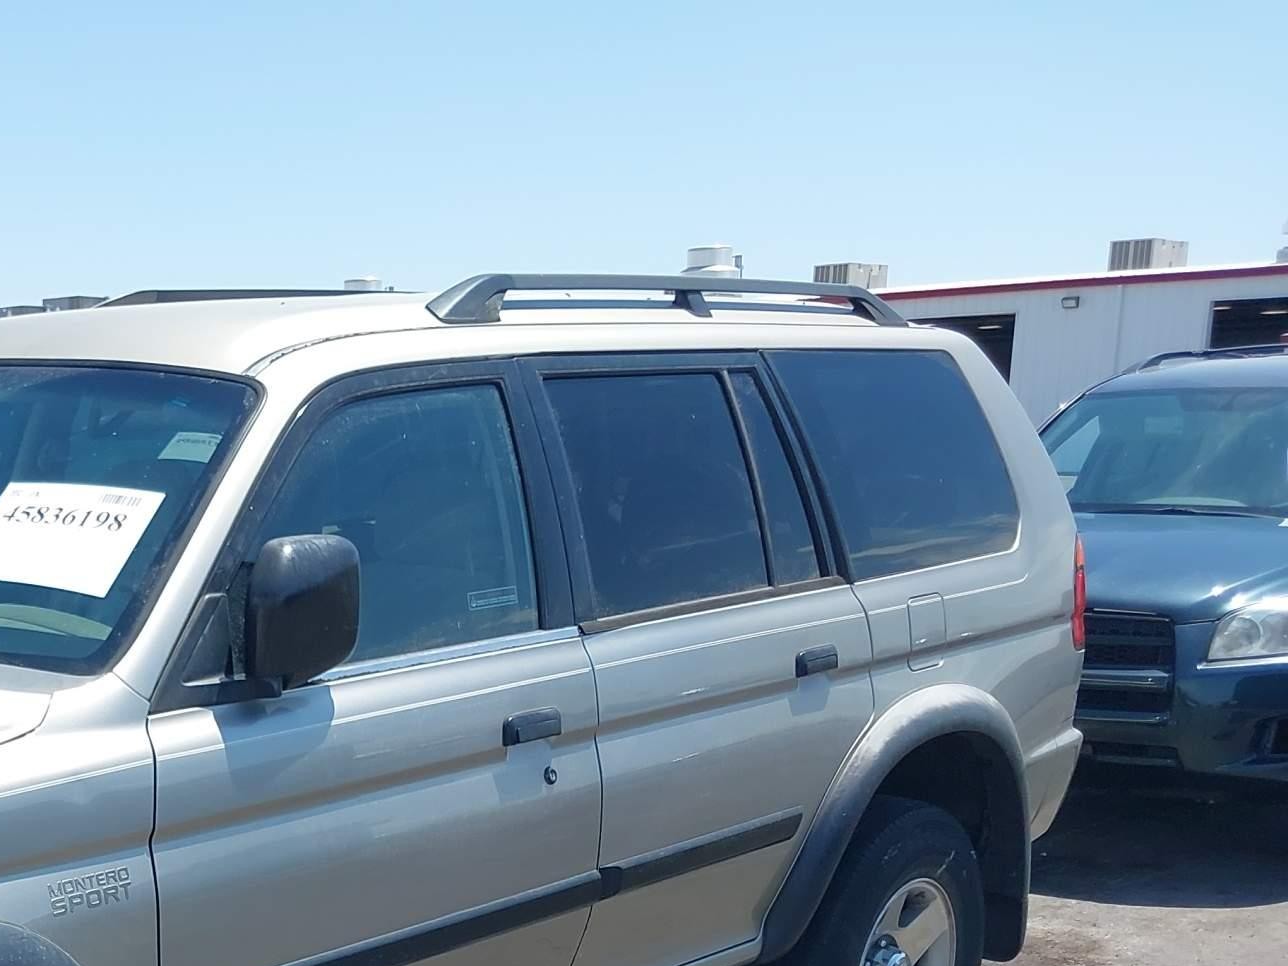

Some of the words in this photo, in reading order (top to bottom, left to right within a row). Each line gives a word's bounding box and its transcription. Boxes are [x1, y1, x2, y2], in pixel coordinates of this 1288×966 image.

[2, 505, 129, 533] 45836198
[47, 866, 131, 898] MONTERO
[50, 881, 132, 917] SPORT
